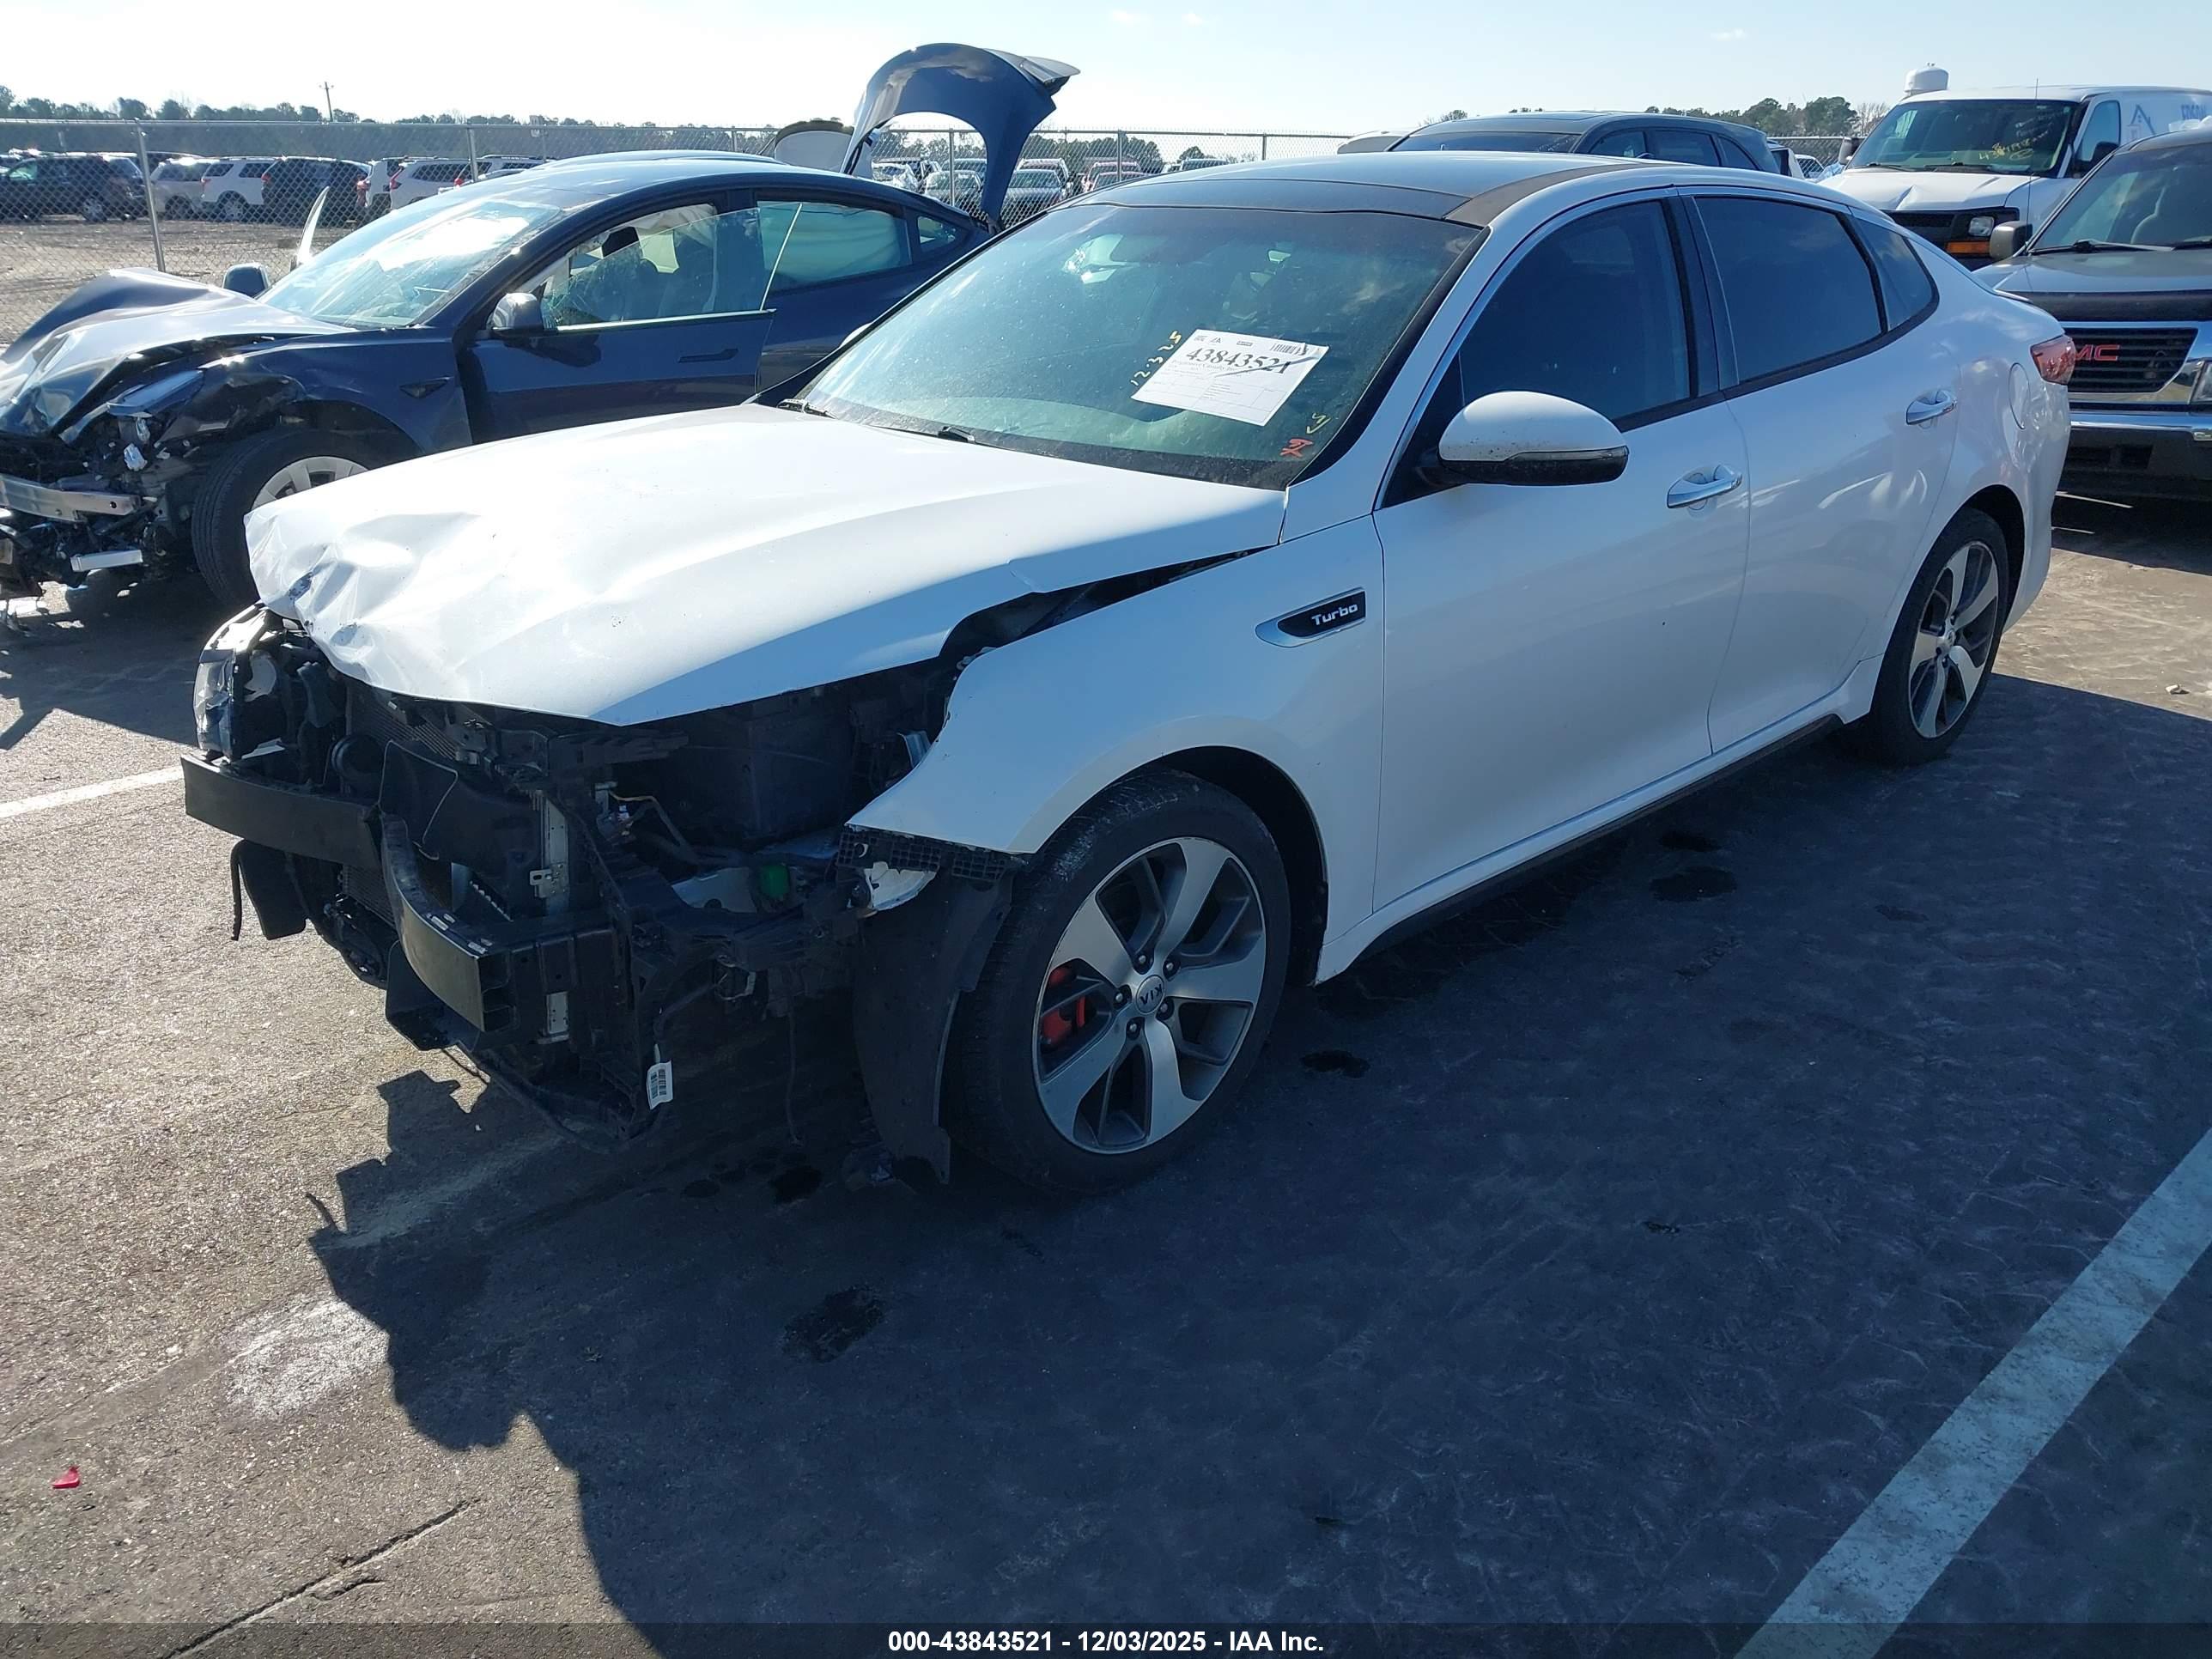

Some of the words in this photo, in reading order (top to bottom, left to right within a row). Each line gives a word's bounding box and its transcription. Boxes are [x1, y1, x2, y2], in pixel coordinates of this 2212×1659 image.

[1186, 347, 1291, 374] 43843521
[2075, 344, 2120, 361] MC
[1311, 604, 1358, 625] Turbo
